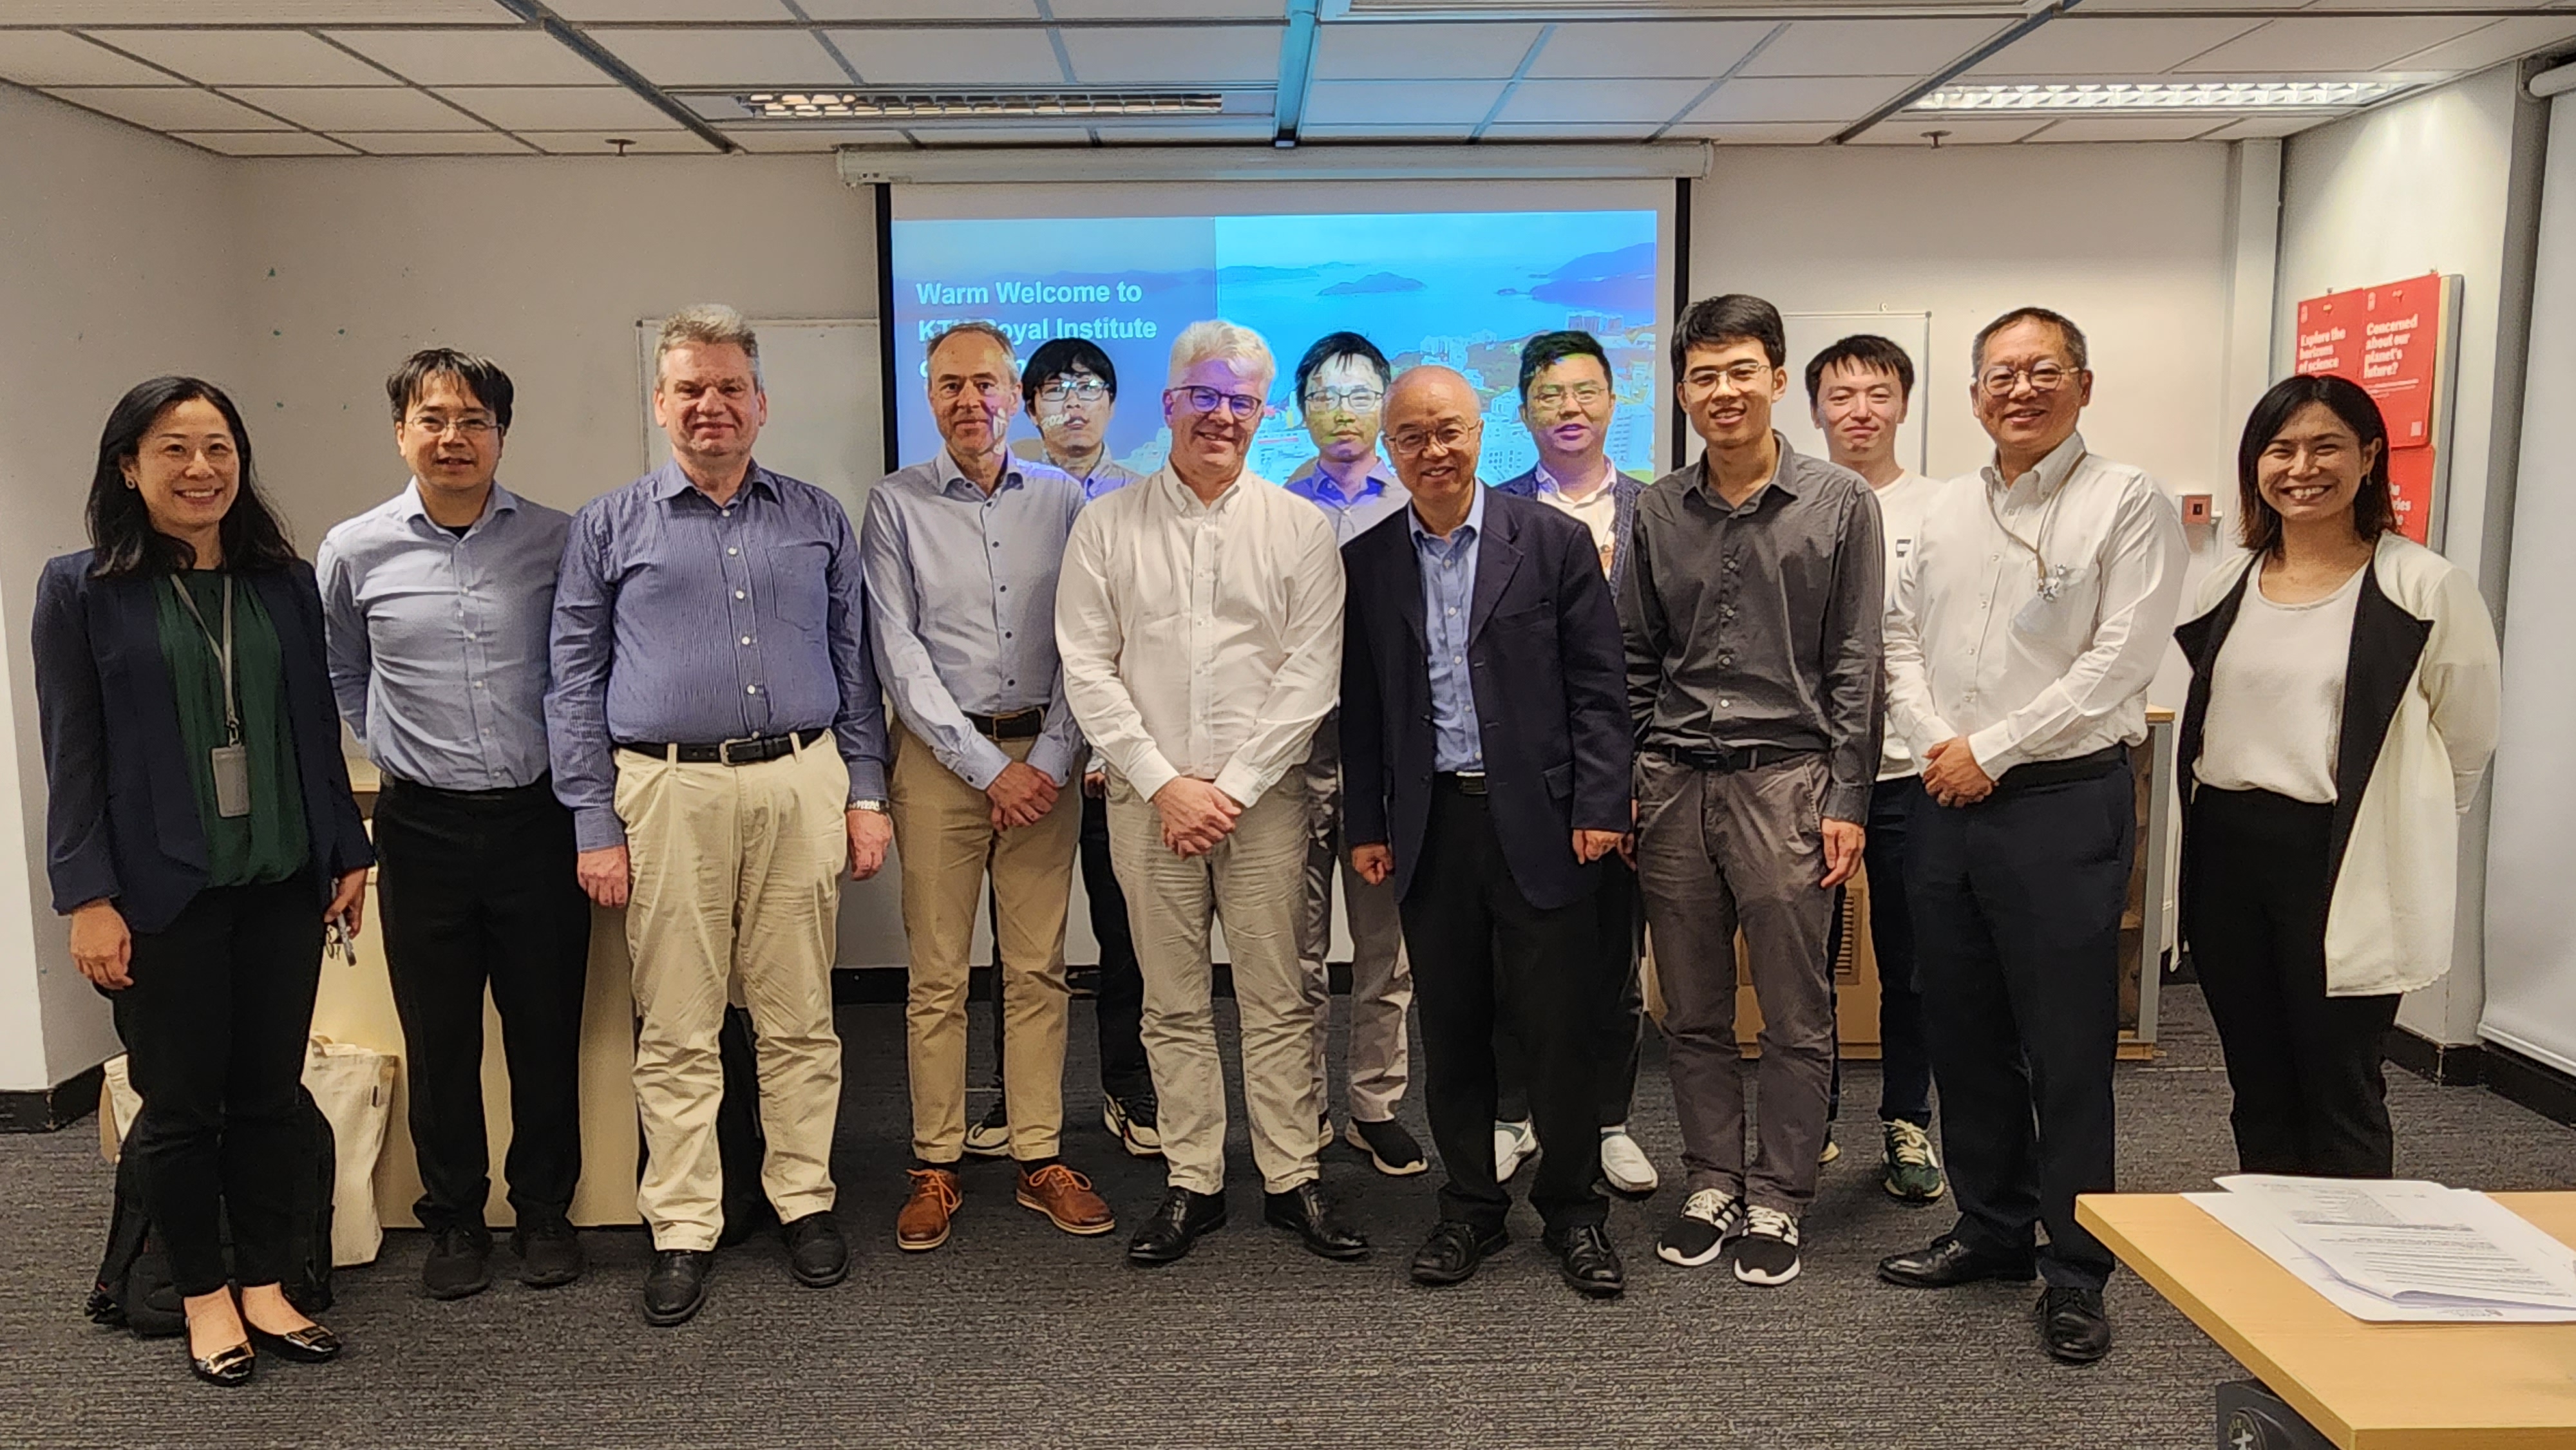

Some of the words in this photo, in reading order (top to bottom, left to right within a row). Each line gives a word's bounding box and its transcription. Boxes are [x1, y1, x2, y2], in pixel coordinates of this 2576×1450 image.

[916, 283, 989, 305] Warm
[996, 281, 1110, 303] Welcome
[1117, 281, 1142, 303] to
[981, 318, 1048, 346] oyal
[1057, 317, 1157, 339] Institute
[2367, 314, 2418, 335] Concerned
[2301, 330, 2330, 347] Explore
[2331, 326, 2346, 341] the
[2365, 334, 2393, 350] about
[2394, 334, 2410, 345] our
[2300, 344, 2334, 360] horizons
[2364, 348, 2403, 364] planet's
[2298, 361, 2308, 373] of
[2309, 357, 2339, 372] science
[2363, 362, 2398, 379] future?
